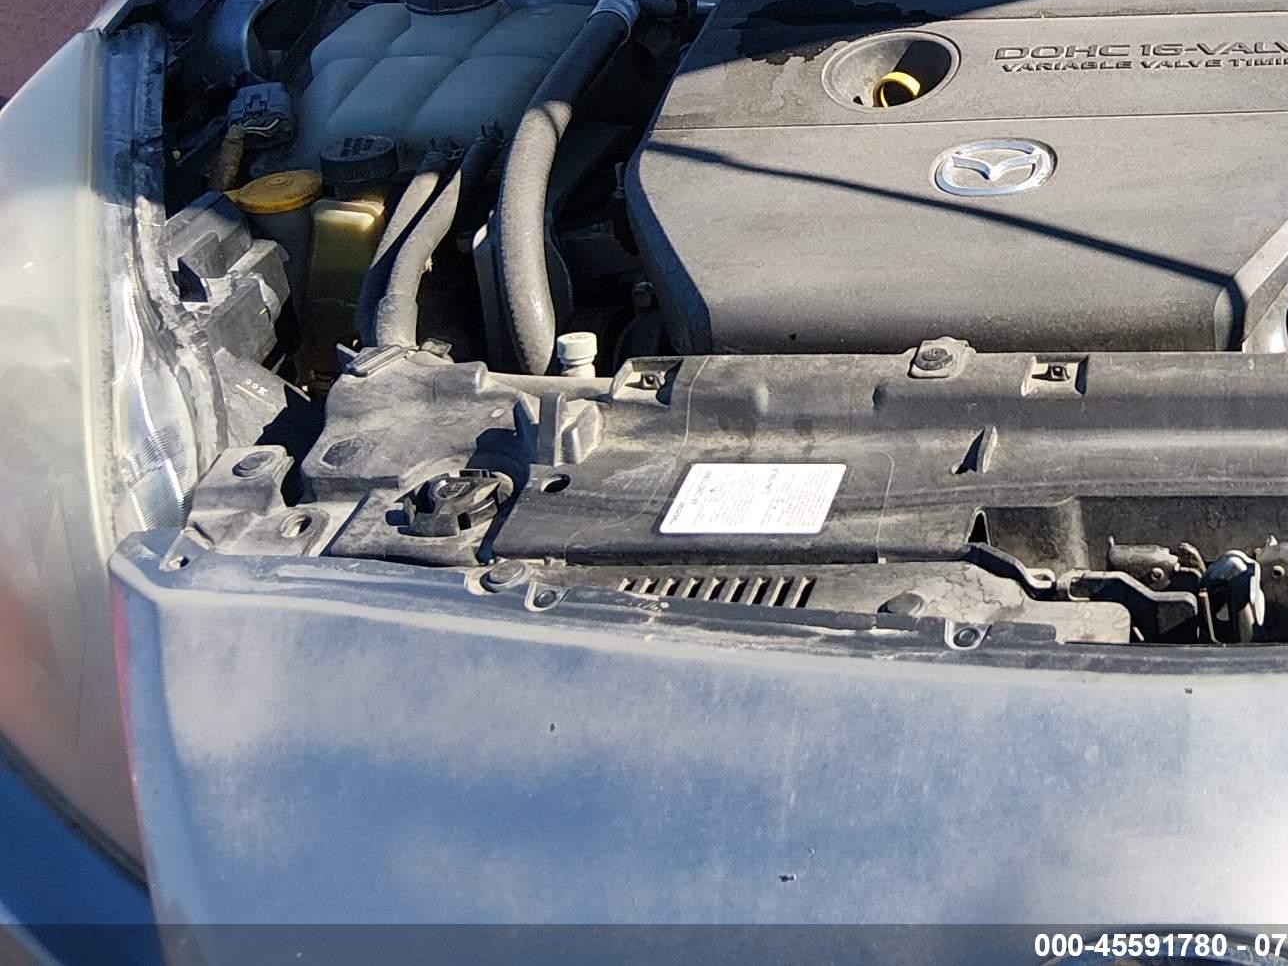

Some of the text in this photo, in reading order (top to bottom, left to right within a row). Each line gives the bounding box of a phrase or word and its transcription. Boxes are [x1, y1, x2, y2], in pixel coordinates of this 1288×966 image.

[994, 44, 1131, 61] DOHC
[1002, 60, 1133, 72] VARIABLE
[1140, 59, 1222, 69] VALVE
